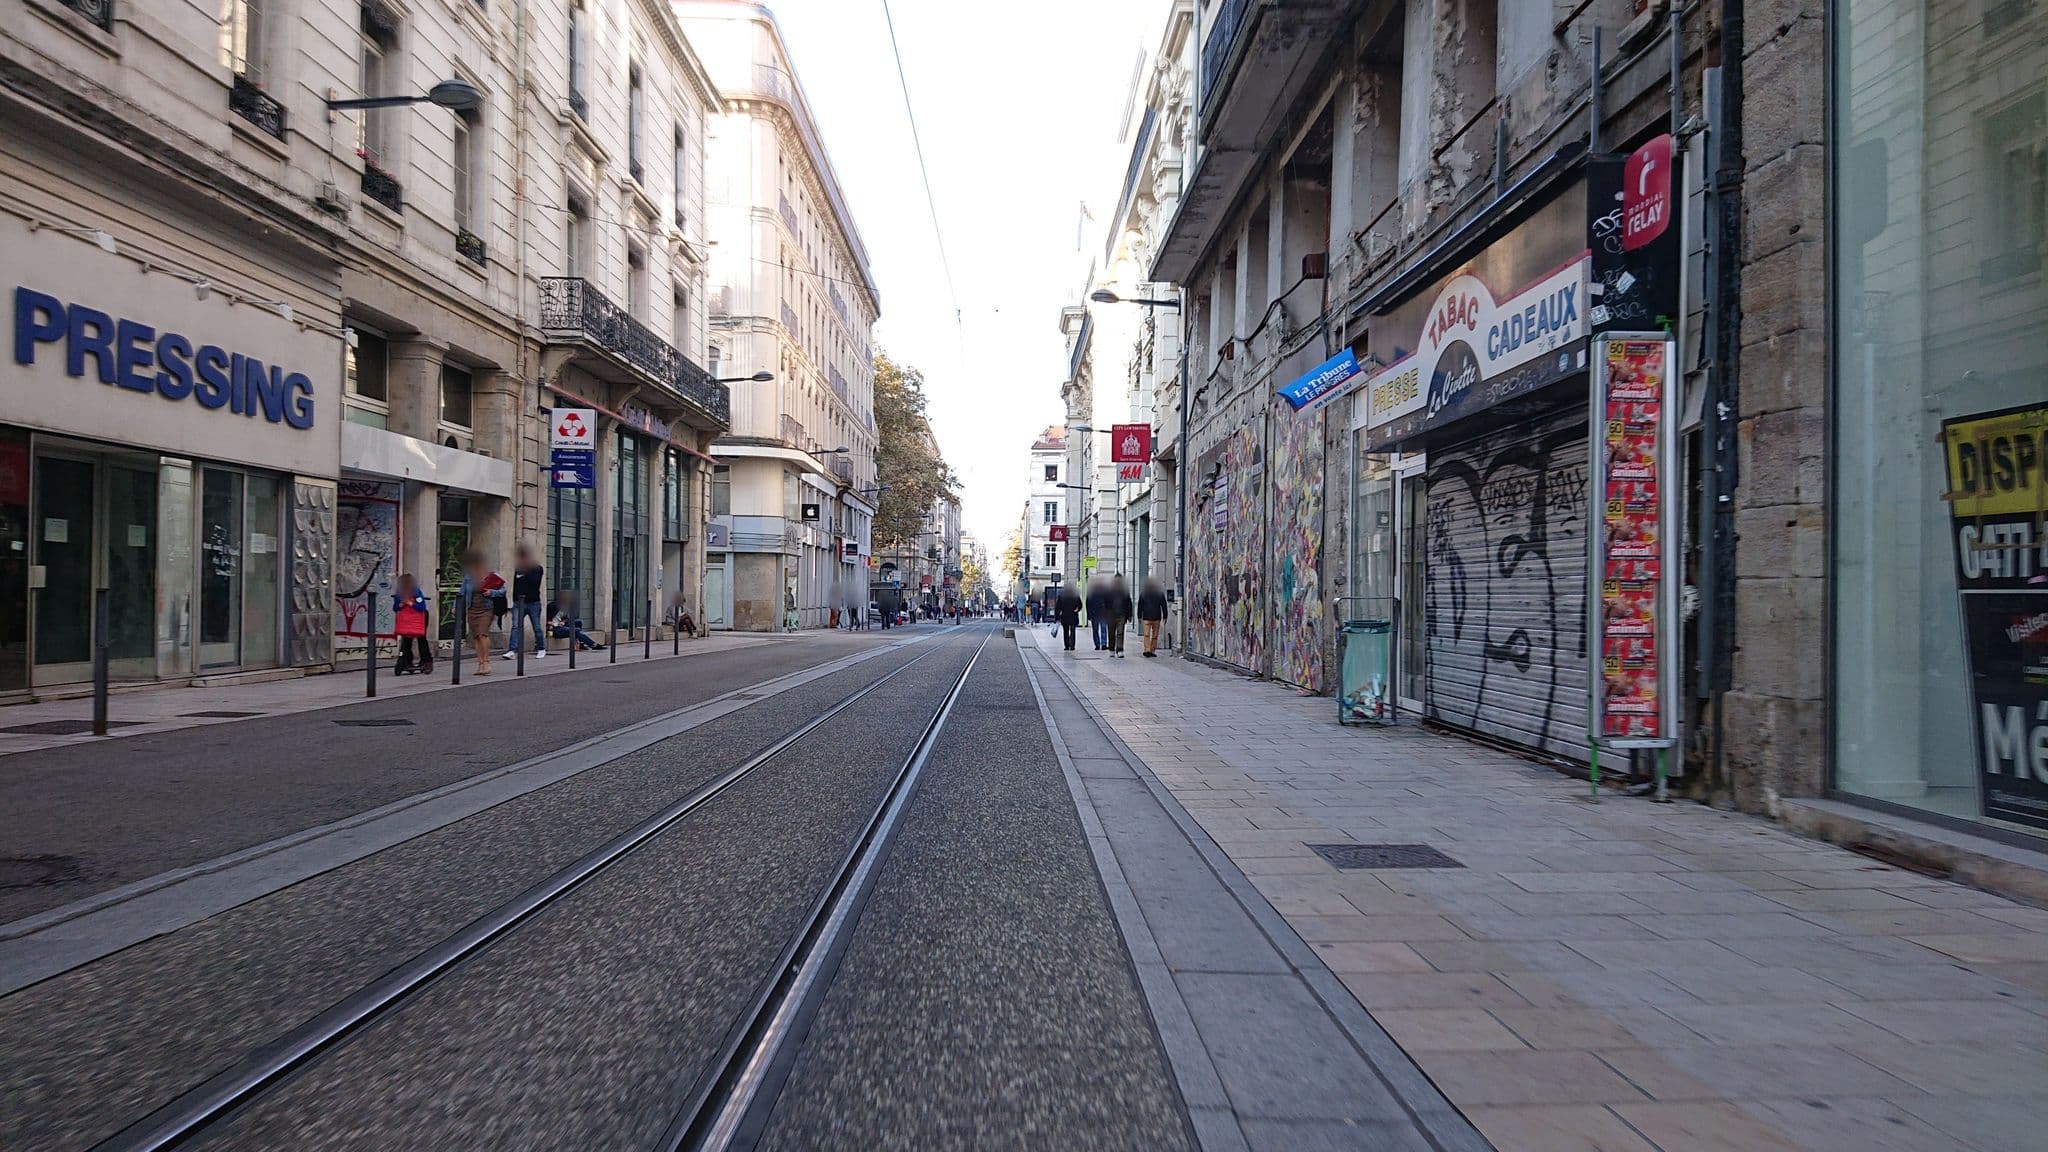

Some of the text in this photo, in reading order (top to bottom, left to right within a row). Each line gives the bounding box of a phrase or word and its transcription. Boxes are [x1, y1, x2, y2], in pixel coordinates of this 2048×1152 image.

[1428, 291, 1479, 350] TABAC
[1487, 281, 1578, 362] CADEAUX
[14, 285, 315, 430] PRESSING
[1293, 359, 1352, 398] La Tribune
[1442, 355, 1477, 406] Civette
[1304, 390, 1316, 401] LE
[1323, 389, 1343, 403] vente
[1372, 367, 1419, 416] PRESSE
